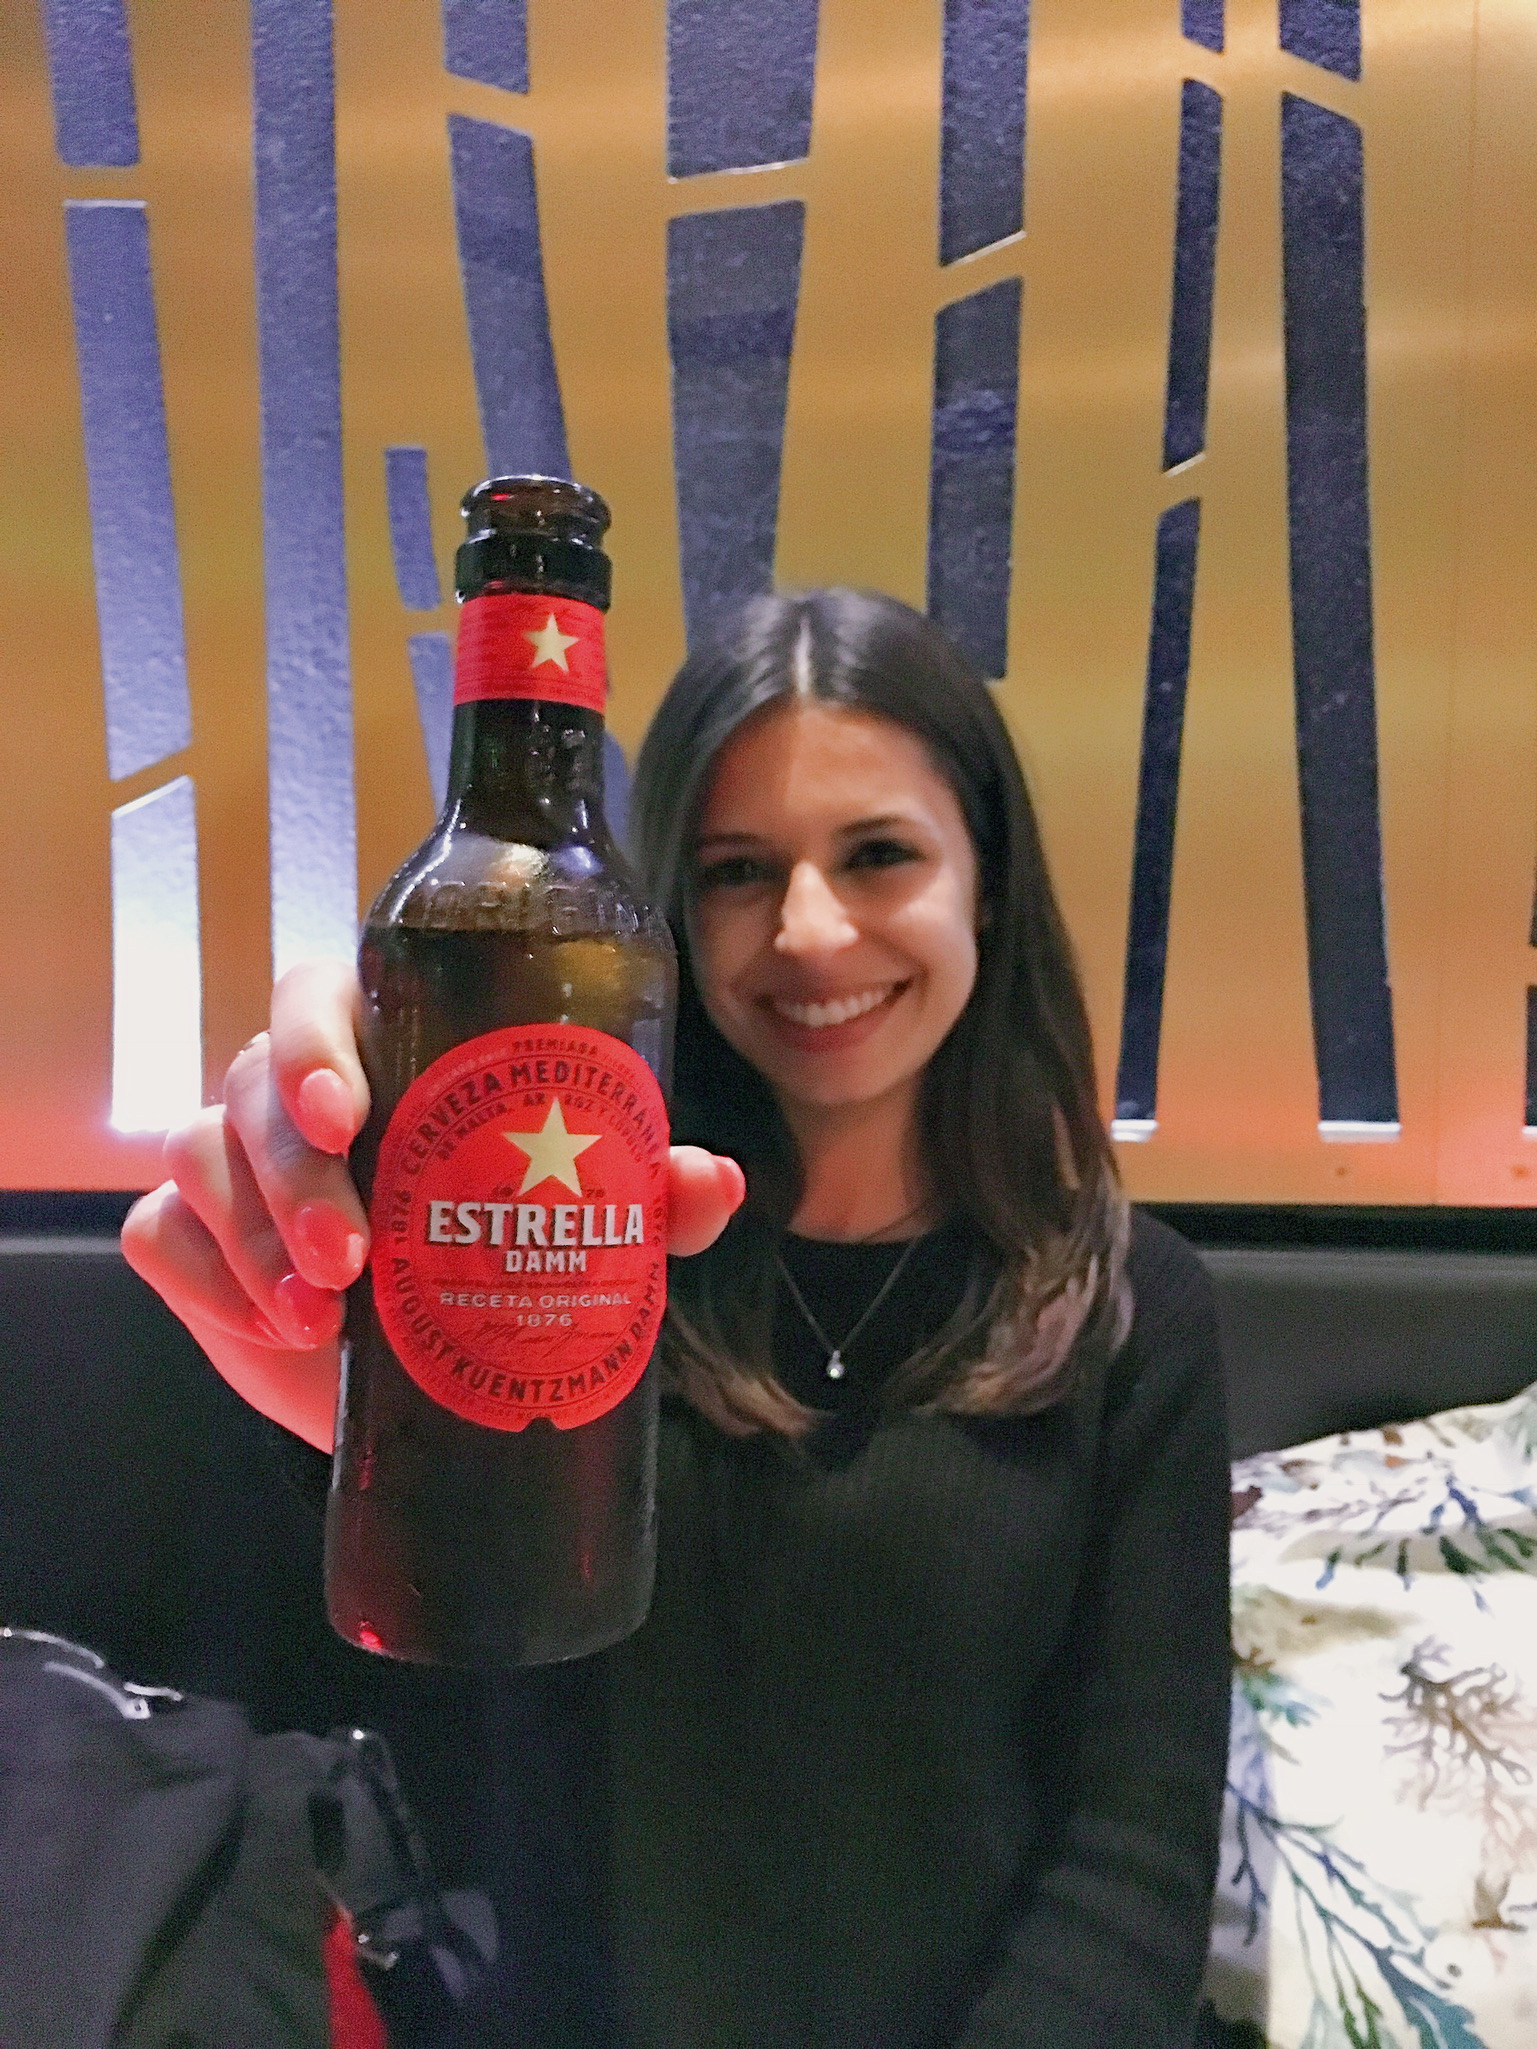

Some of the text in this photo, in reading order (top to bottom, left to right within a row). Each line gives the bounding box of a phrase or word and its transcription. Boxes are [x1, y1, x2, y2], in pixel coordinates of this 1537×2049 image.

[402, 1070, 503, 1175] CERVEZA
[428, 1200, 645, 1246] ESTRELLA
[505, 1250, 587, 1273] DAMM
[439, 1291, 632, 1309] RECETA ORIGINAL
[391, 1257, 457, 1362] AUGUST
[451, 1341, 634, 1403] KUENTZMANN
[516, 1312, 574, 1328] 1876
